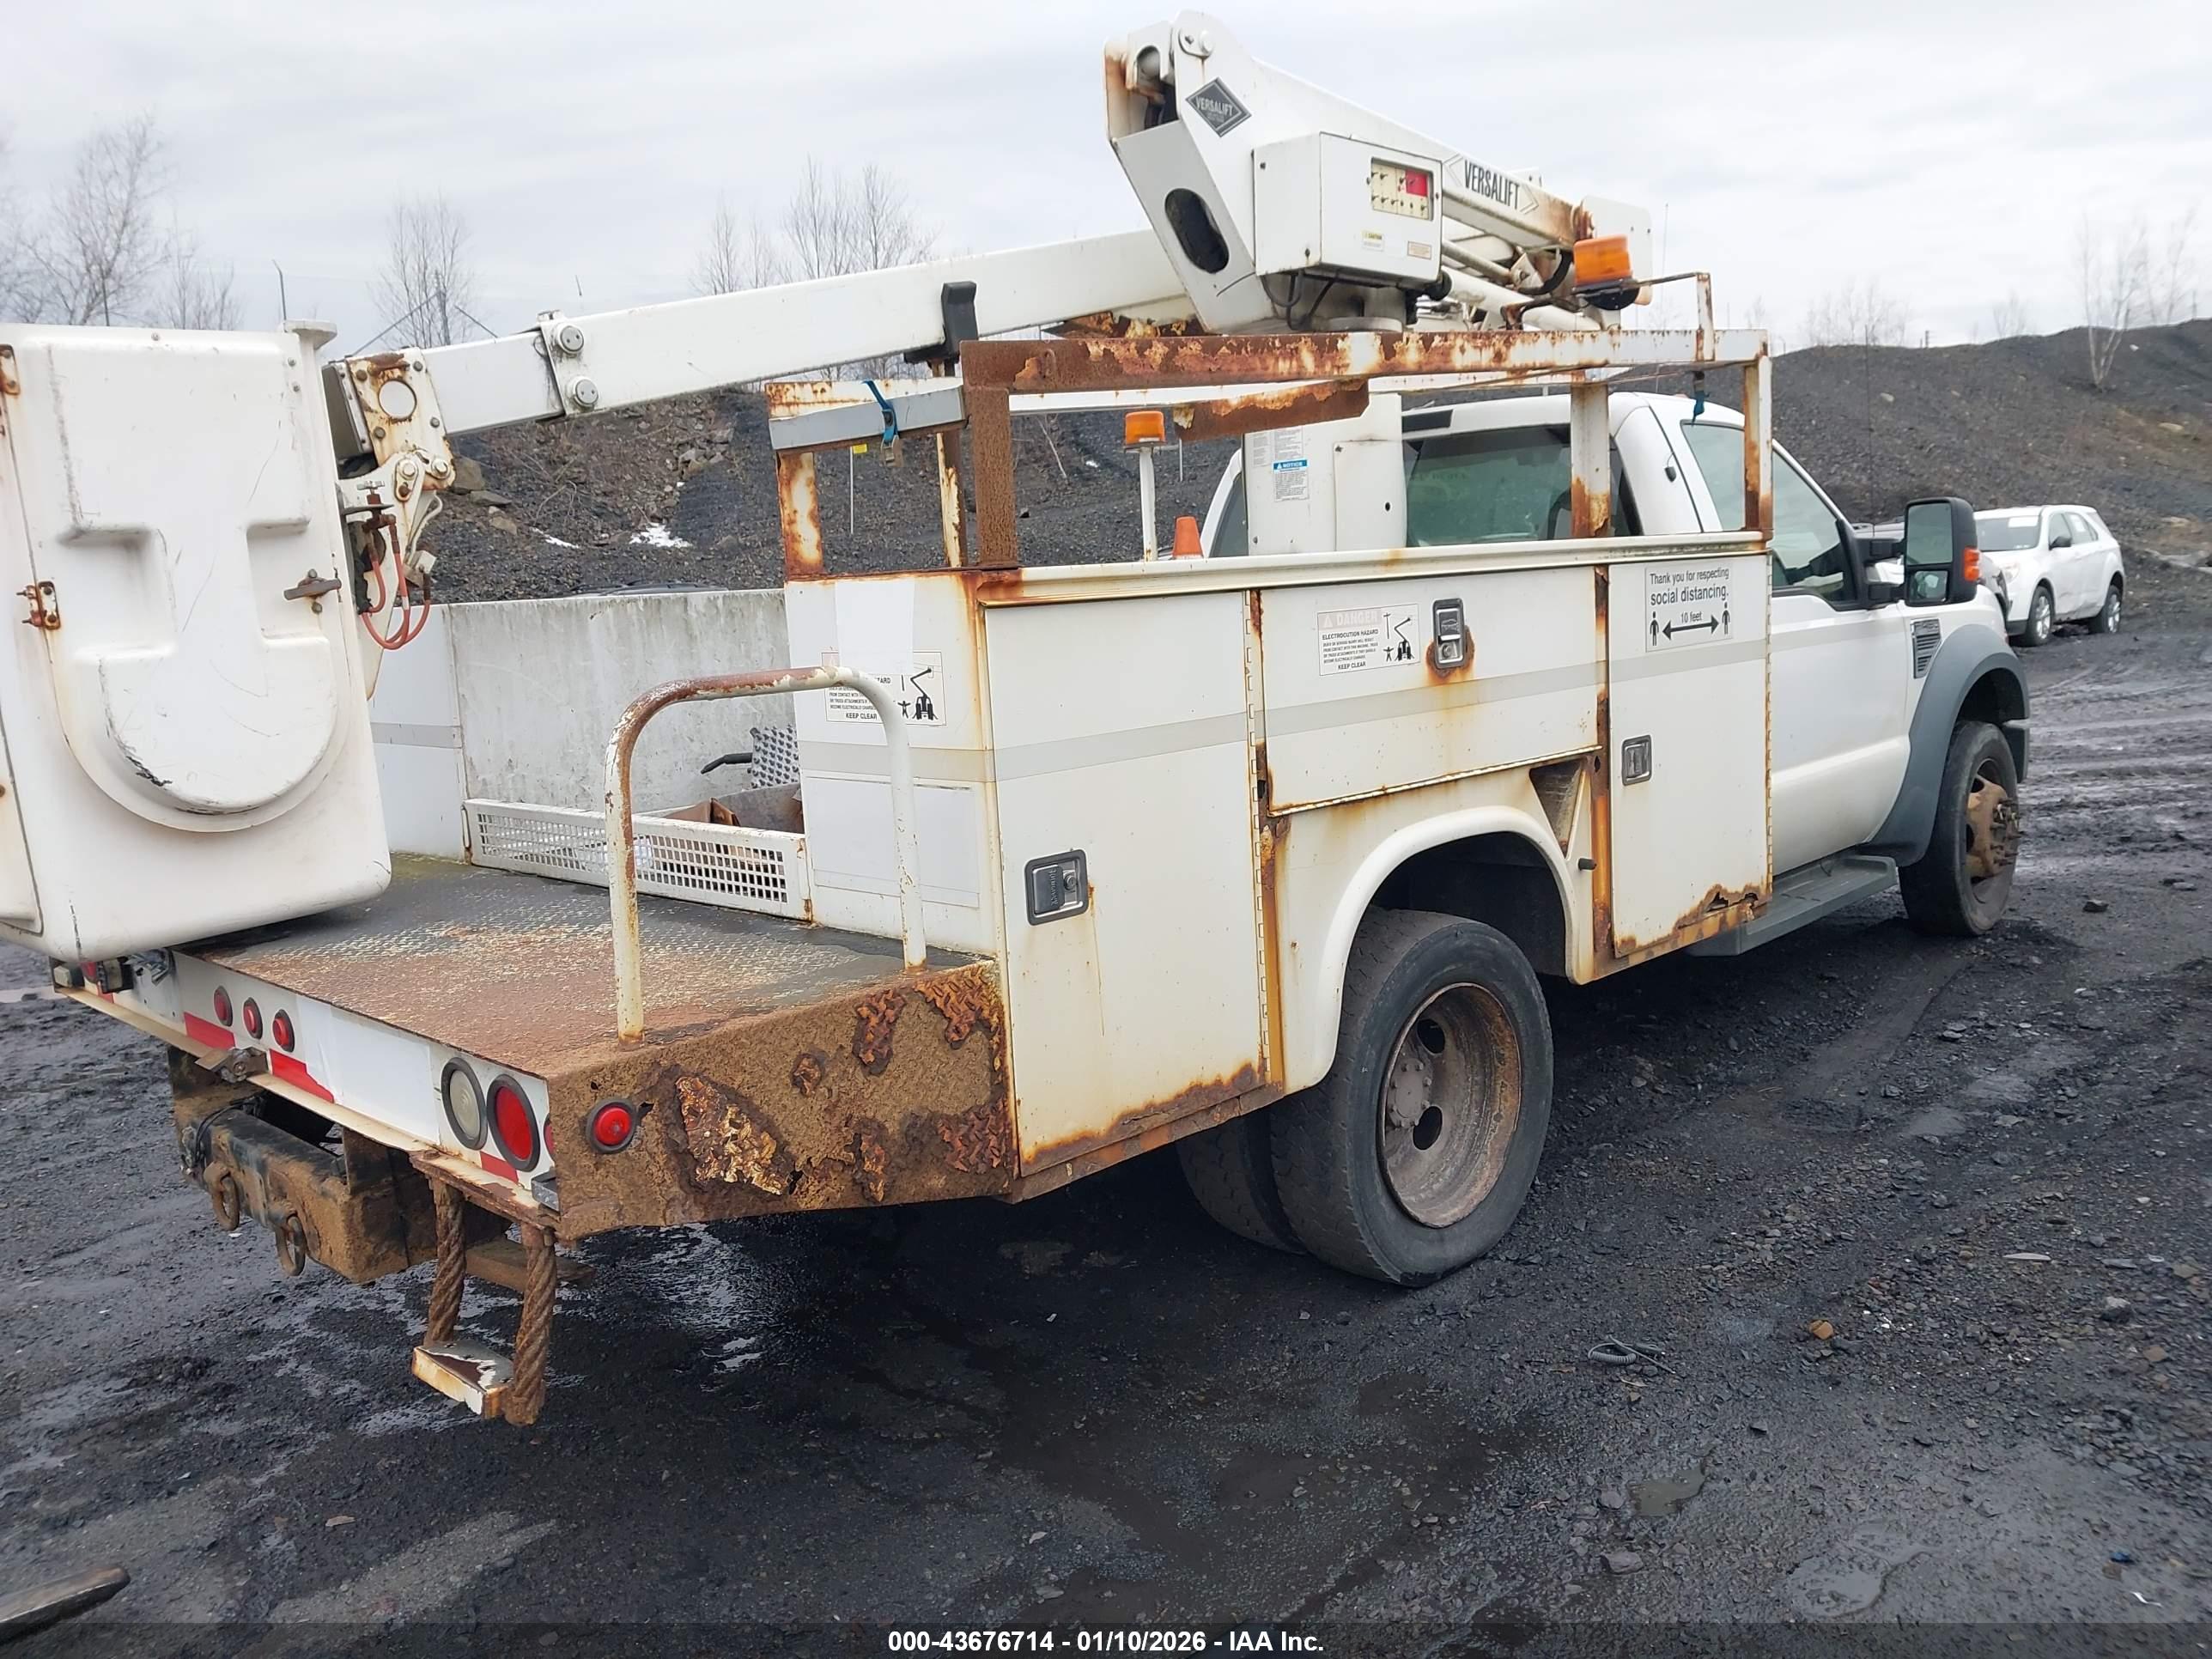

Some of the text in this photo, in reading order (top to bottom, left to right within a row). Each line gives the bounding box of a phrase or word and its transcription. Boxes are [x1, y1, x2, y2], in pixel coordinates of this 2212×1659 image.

[1195, 95, 1233, 117] VERSALIFT
[1464, 159, 1520, 210] VERSALIFT
[1650, 567, 1729, 586] Thank you for respecting
[1650, 584, 1729, 605] social distancing.
[1336, 611, 1379, 626] DANGER
[1680, 611, 1703, 623] 10 feet
[1322, 631, 1359, 641] ELECTROCUTION
